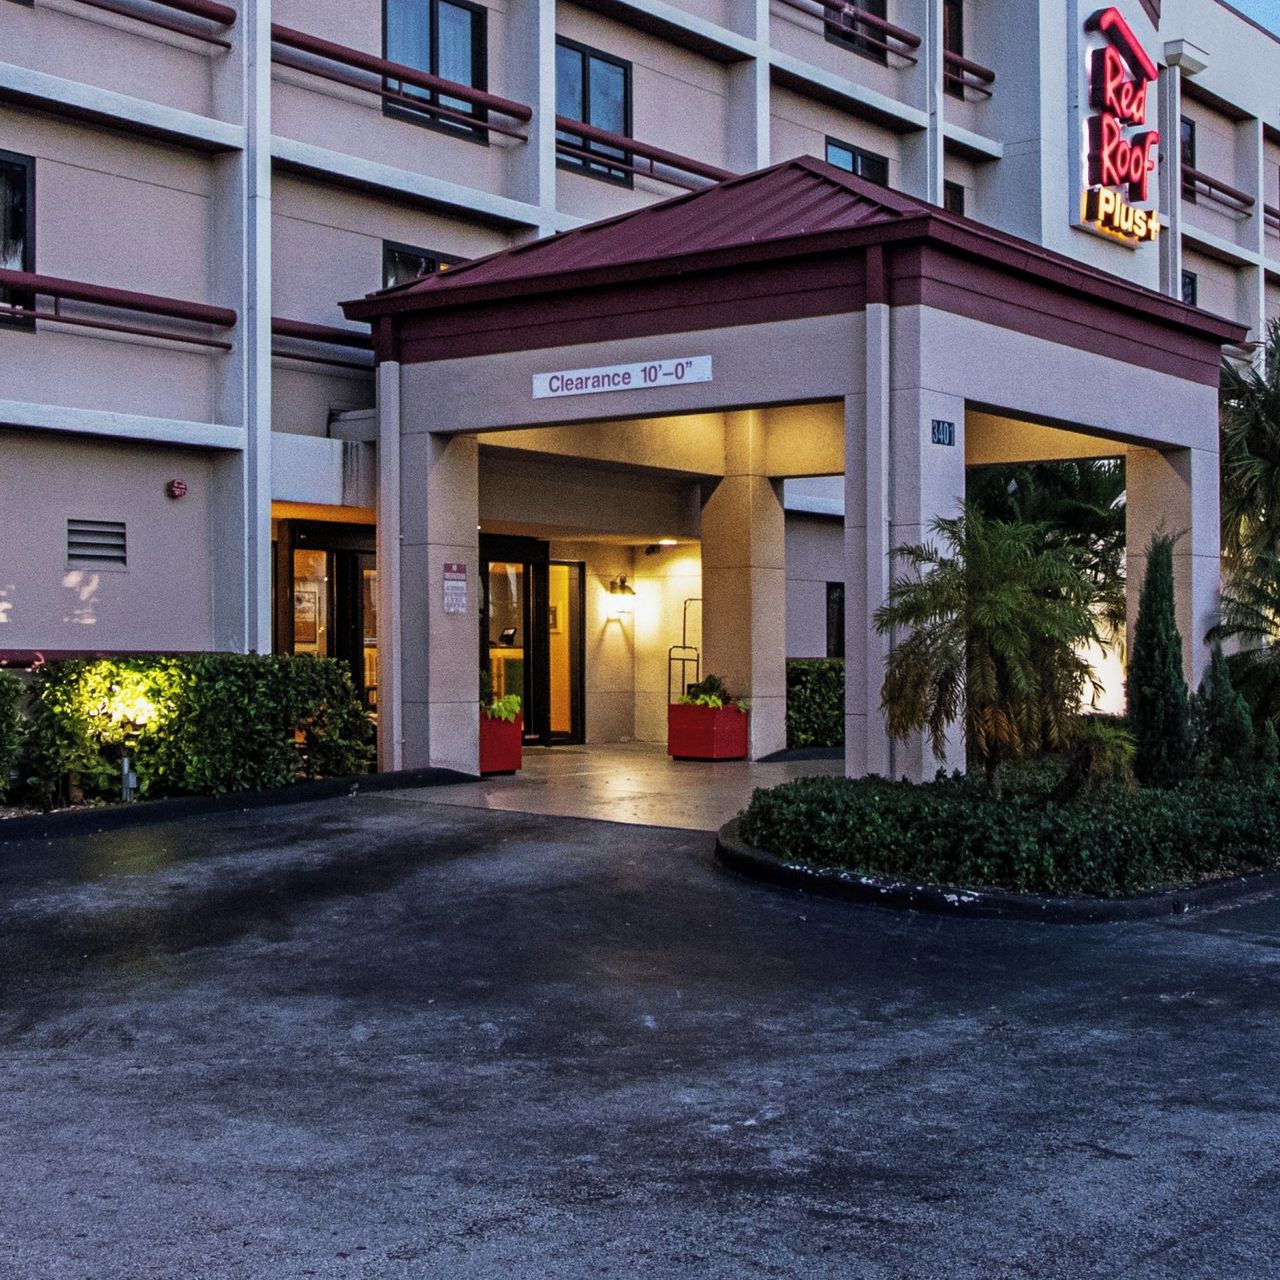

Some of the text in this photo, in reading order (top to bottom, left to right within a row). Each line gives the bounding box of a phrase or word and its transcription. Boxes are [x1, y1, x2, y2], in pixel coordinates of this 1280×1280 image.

[1094, 45, 1148, 124] Red
[1092, 112, 1160, 202] Roof
[1094, 187, 1160, 240] Plus+
[549, 371, 631, 393] Clearance
[932, 420, 955, 445] 3401
